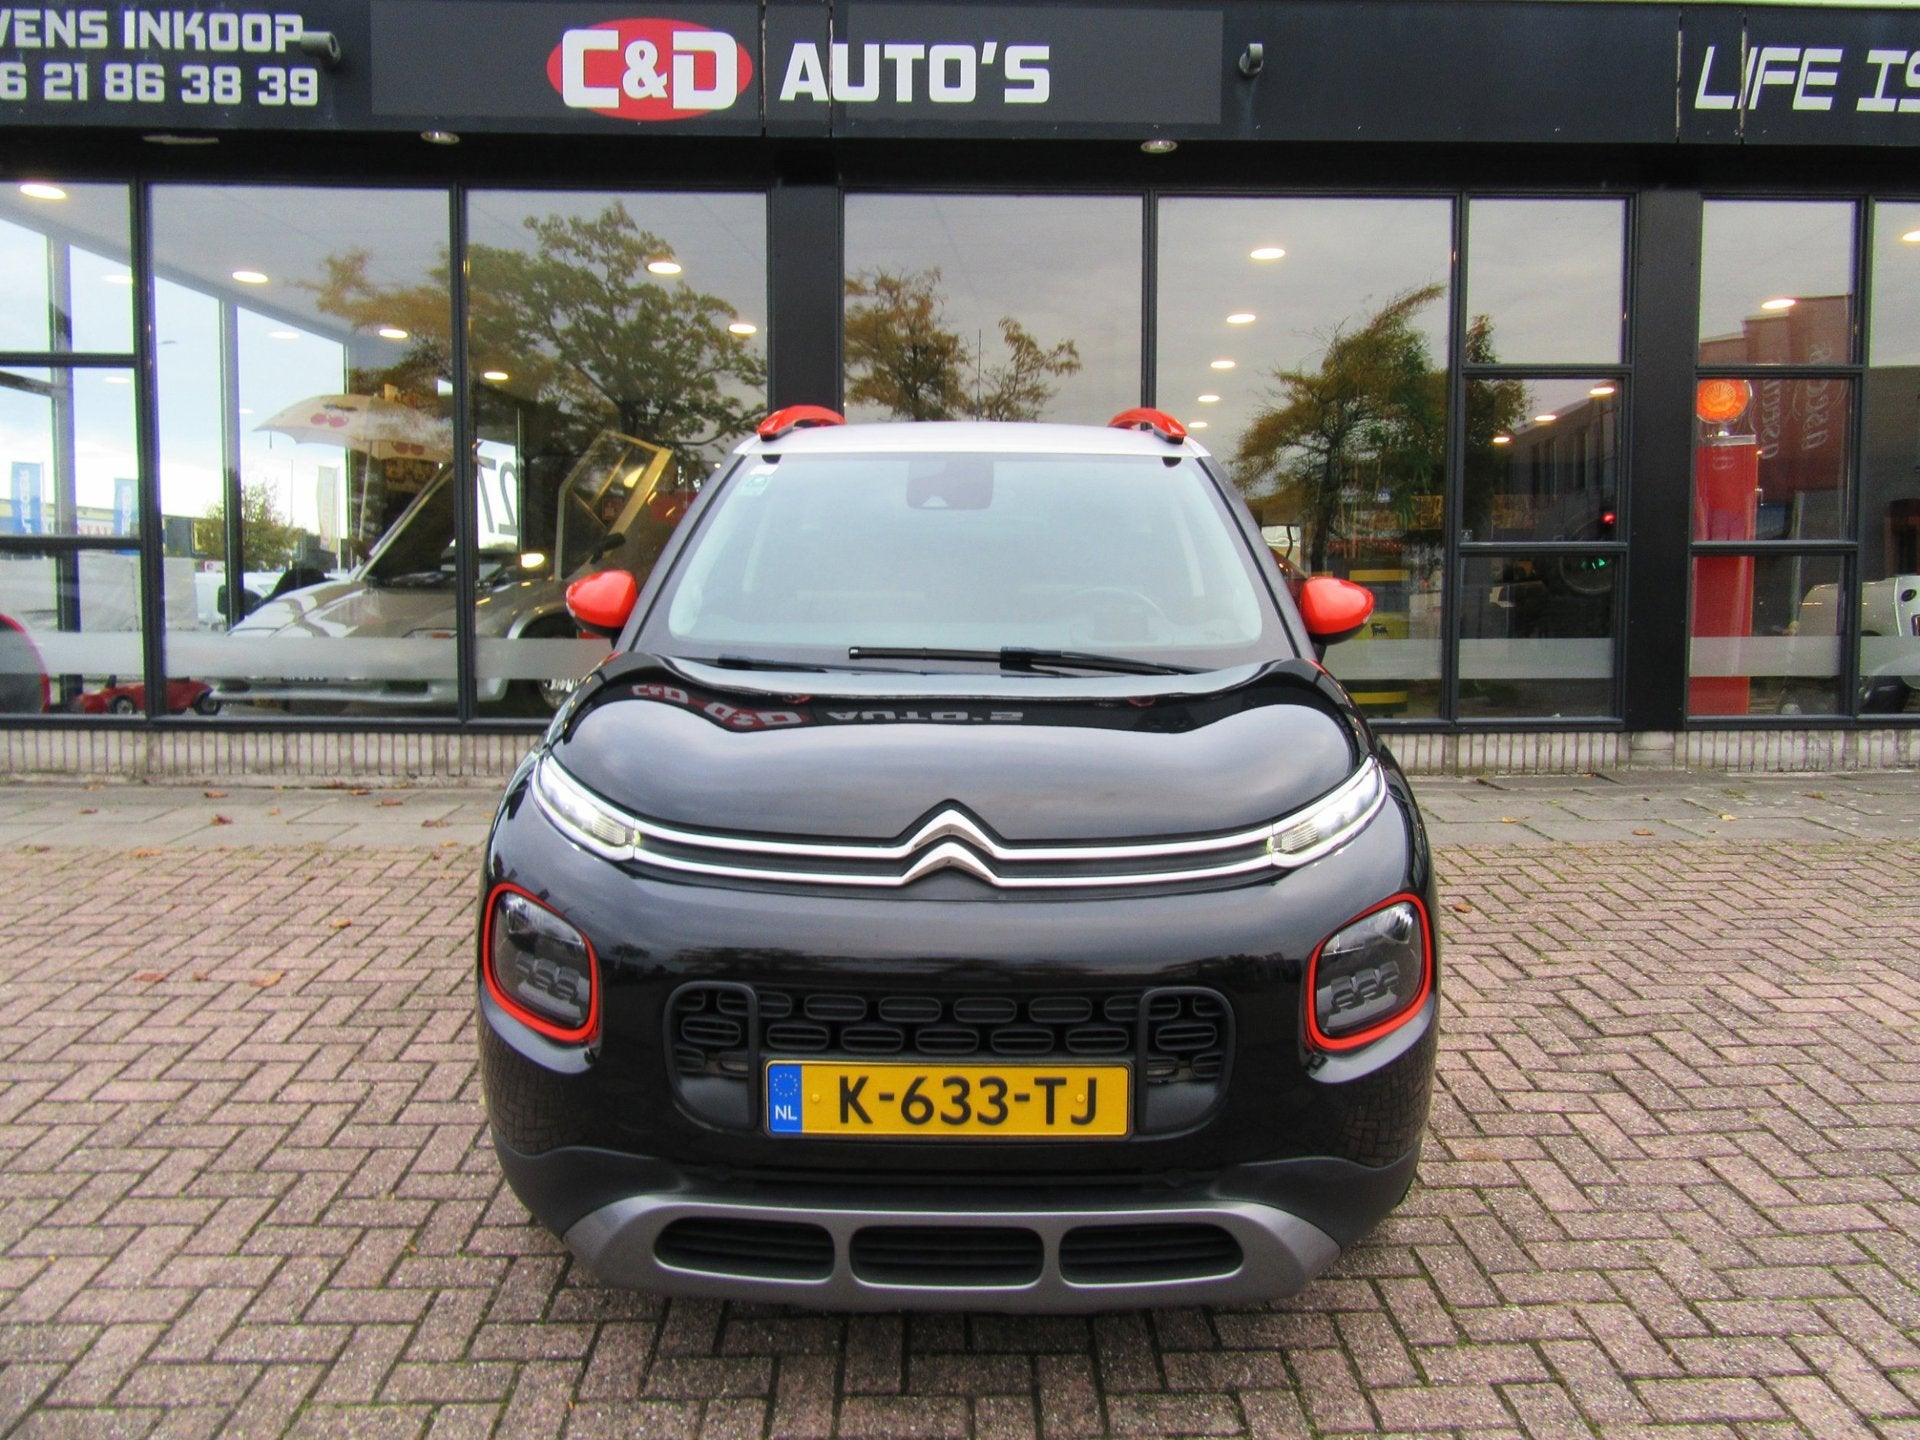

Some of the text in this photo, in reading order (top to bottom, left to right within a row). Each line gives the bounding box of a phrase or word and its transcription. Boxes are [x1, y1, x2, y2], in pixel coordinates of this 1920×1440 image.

[124, 11, 304, 52] INKOOP
[0, 62, 318, 105] 6 21 86 38 39
[562, 28, 1050, 110] C&D AUTO'S
[1695, 46, 1843, 110] LIFE
[774, 1105, 798, 1121] NL
[838, 1075, 1097, 1125] K-633-TJ
